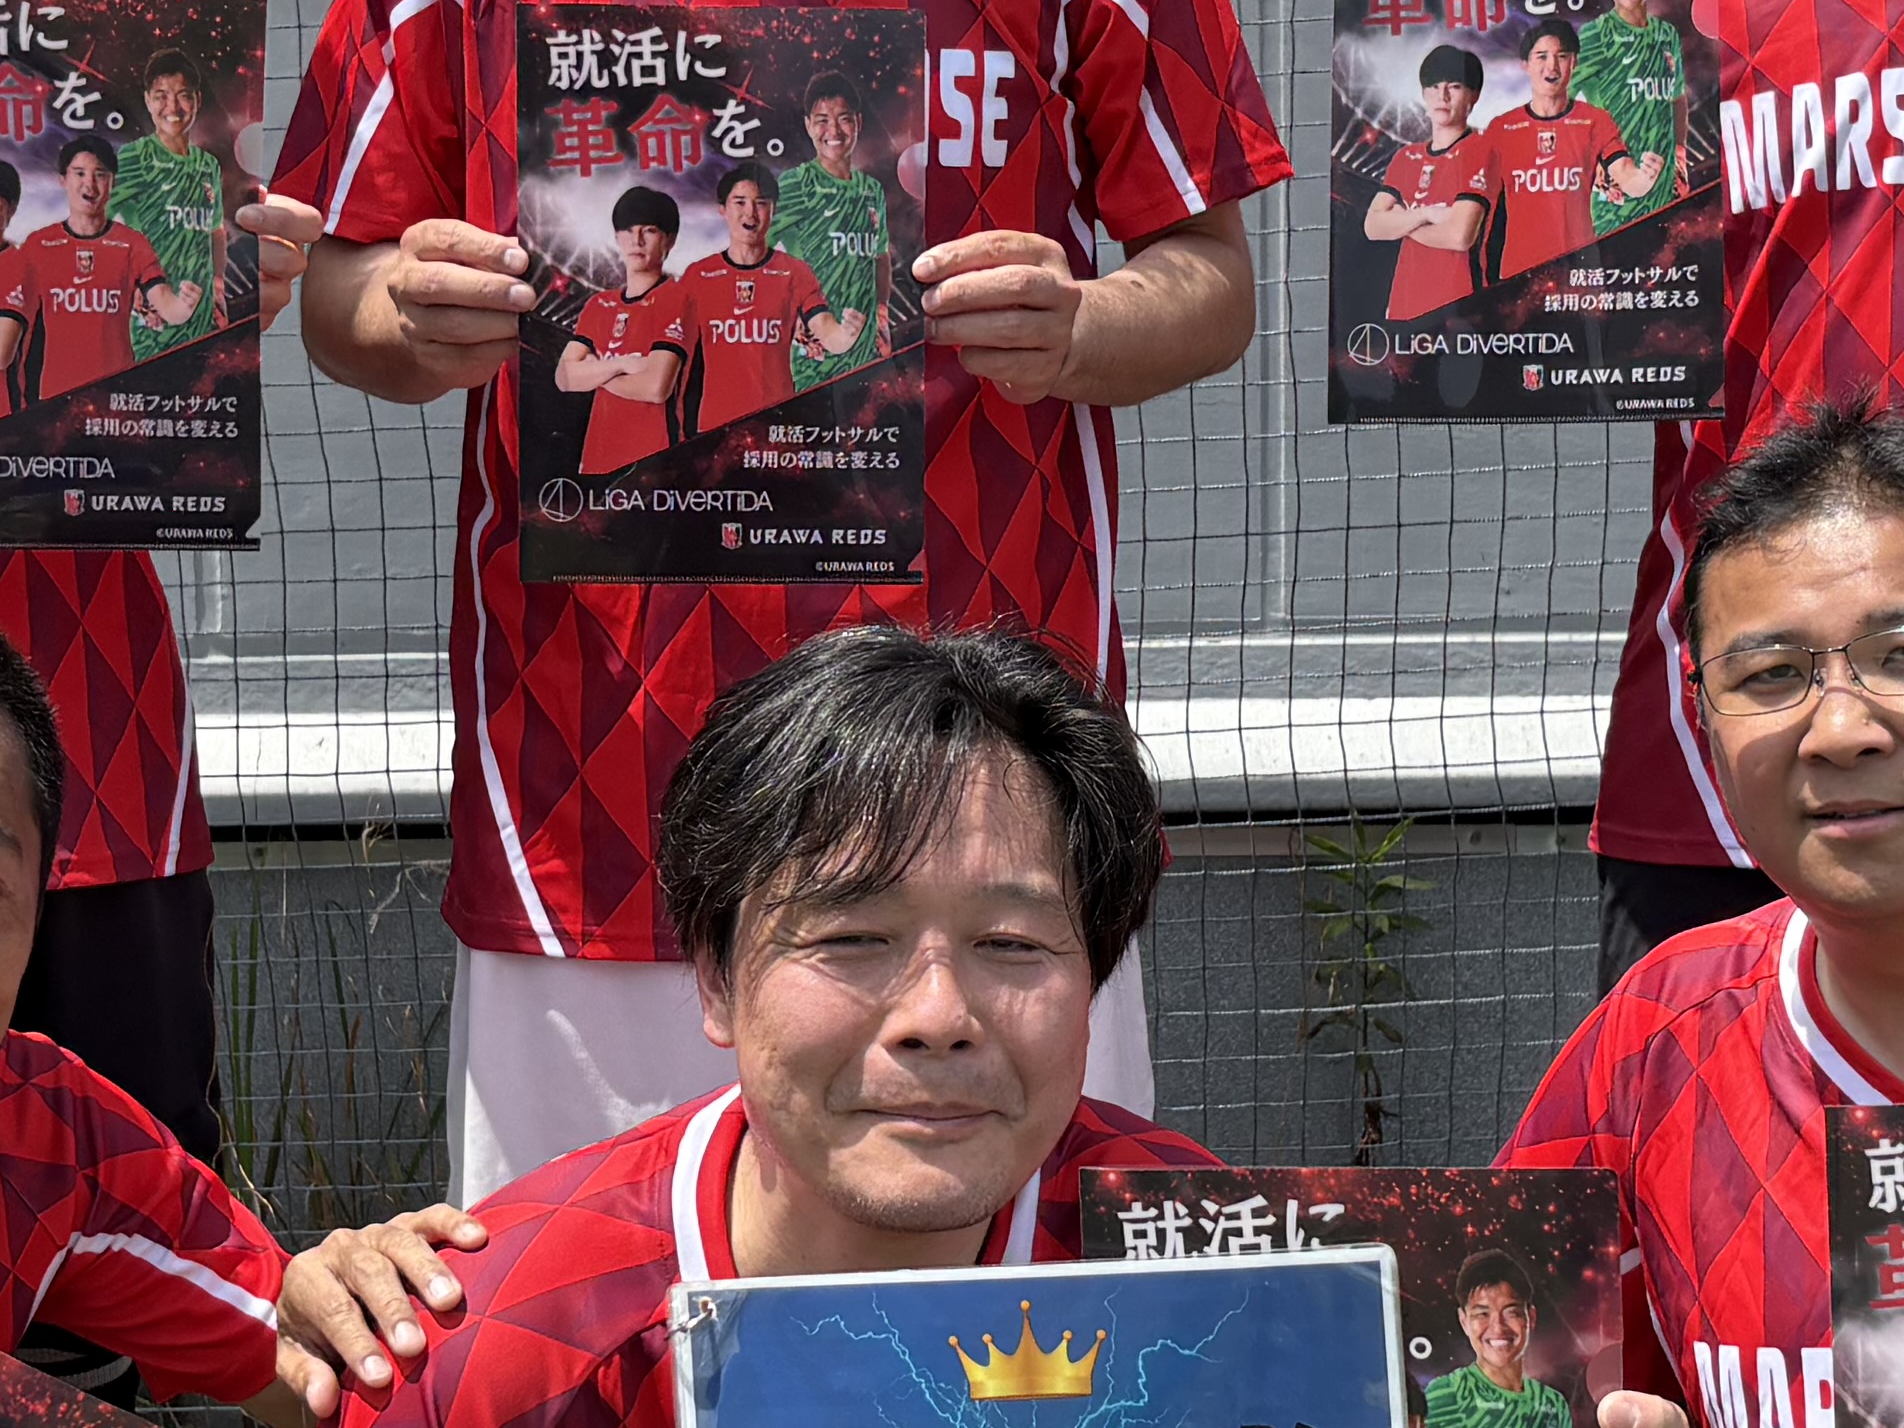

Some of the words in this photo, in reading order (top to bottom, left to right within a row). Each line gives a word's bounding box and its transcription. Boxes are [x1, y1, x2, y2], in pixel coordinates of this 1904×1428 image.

[545, 28, 727, 90] 就活に
[925, 48, 1015, 167] SE
[544, 94, 785, 178] 革命を。
[1513, 166, 1583, 193] POLUS
[1569, 265, 1699, 286] 就活フットサルで
[50, 289, 120, 314] POLUS
[1544, 290, 1700, 310] 採用の常識を変える
[709, 319, 782, 344] POLUS
[1551, 366, 1623, 385] URAWA
[1632, 365, 1686, 383] REDS
[109, 393, 238, 413] 就活フットサルで
[85, 417, 239, 439] 採用の常識を変える
[768, 424, 900, 443] 就活フットサルで
[742, 450, 900, 469] 採用の常識を変える
[92, 494, 164, 512] URAWA
[173, 494, 226, 512] REDS
[750, 528, 823, 545] URAWA
[831, 528, 886, 545] REDS
